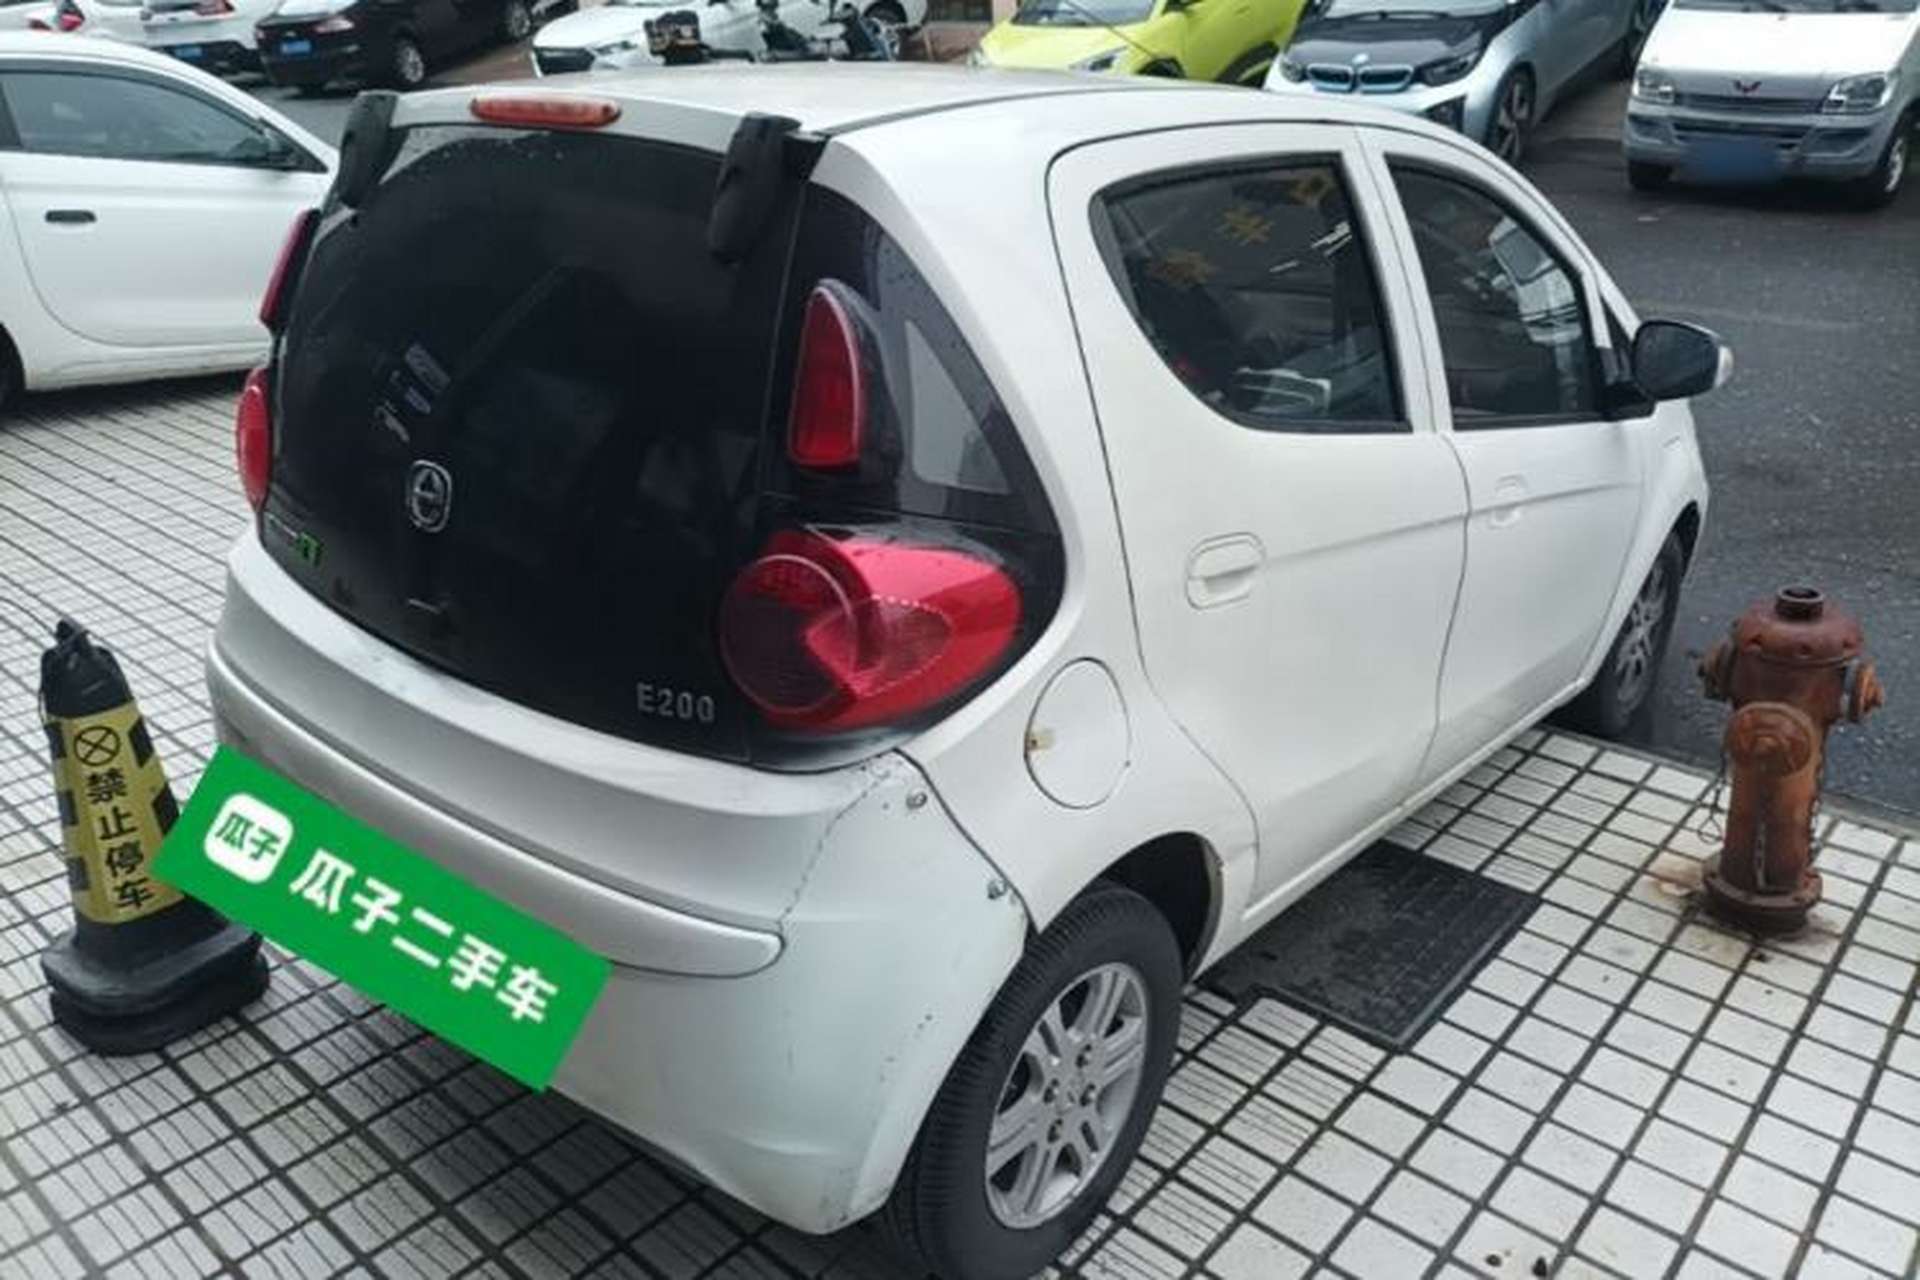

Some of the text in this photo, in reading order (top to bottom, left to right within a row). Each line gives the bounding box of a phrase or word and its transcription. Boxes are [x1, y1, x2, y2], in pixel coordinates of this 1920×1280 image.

[636, 682, 716, 723] E200
[85, 767, 155, 909] 禁止停车
